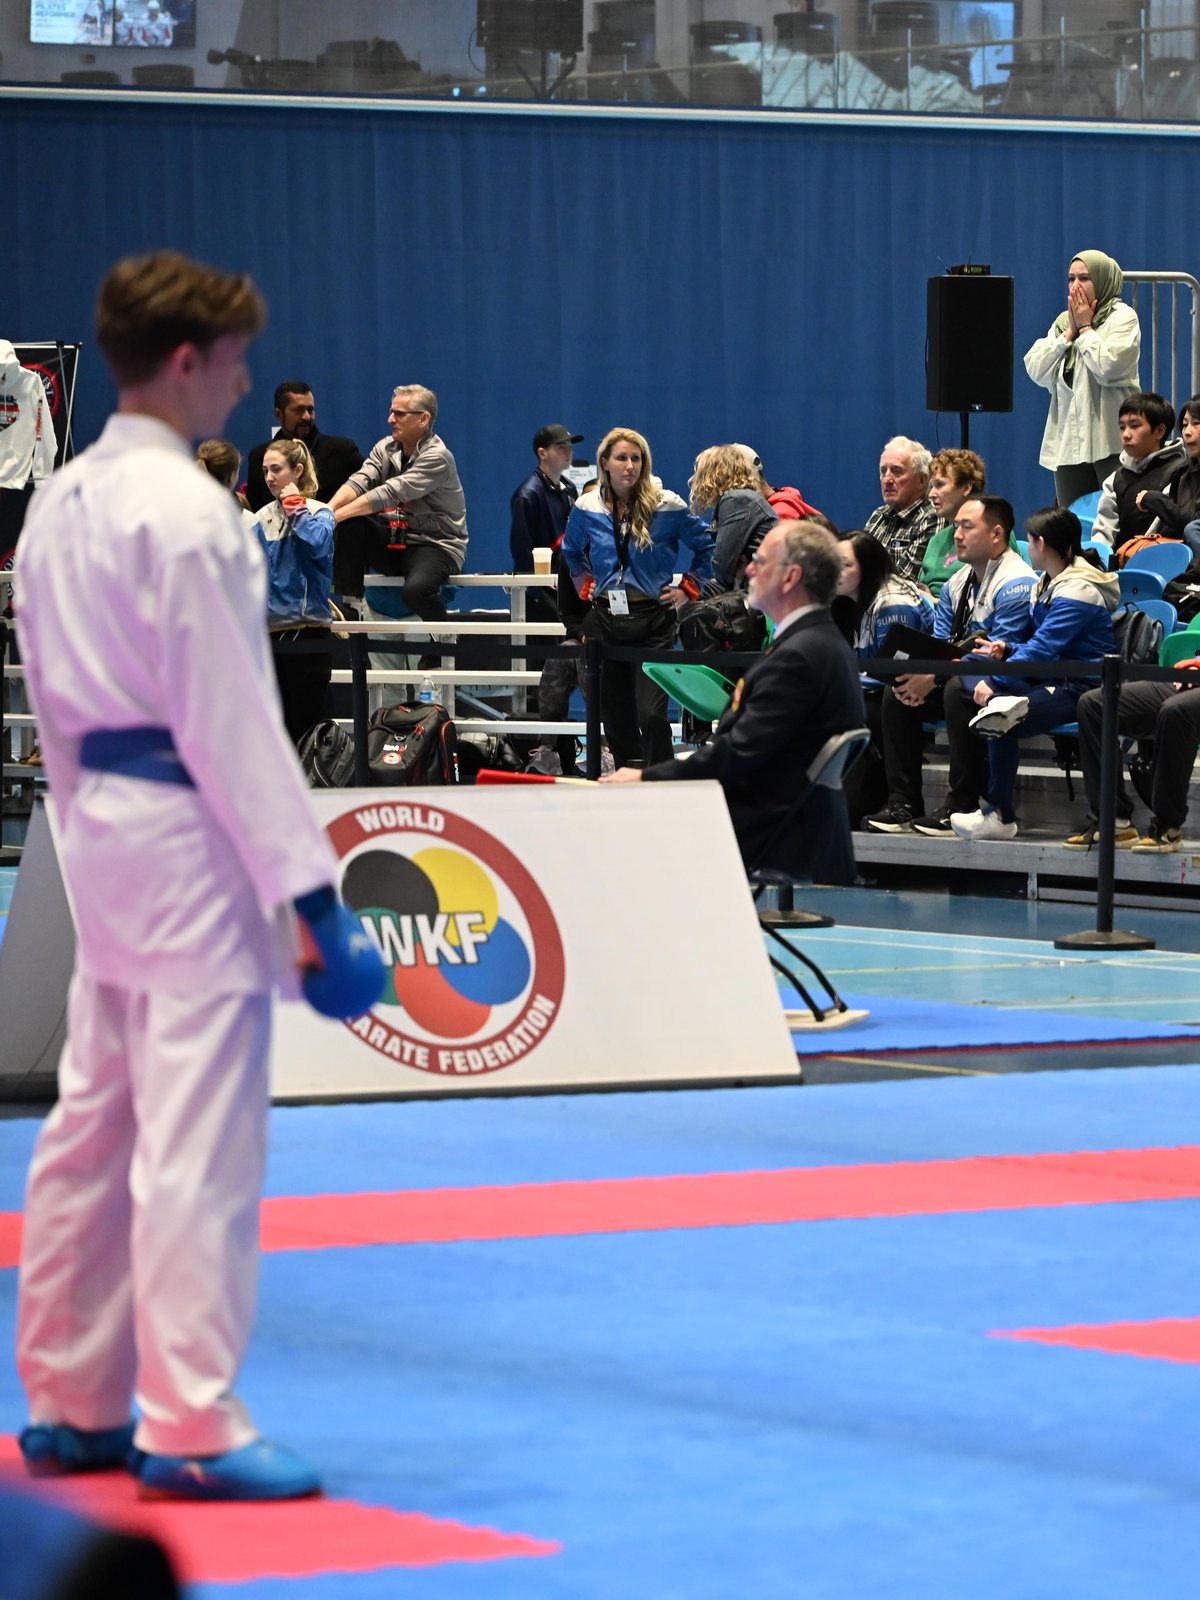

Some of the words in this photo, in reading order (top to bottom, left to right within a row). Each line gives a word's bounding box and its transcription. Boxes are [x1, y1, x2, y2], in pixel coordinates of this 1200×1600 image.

[355, 805, 446, 834] WORLD
[359, 911, 489, 967] WKF
[346, 1014, 430, 1068] ARATE
[438, 993, 557, 1073] FEDERATION
